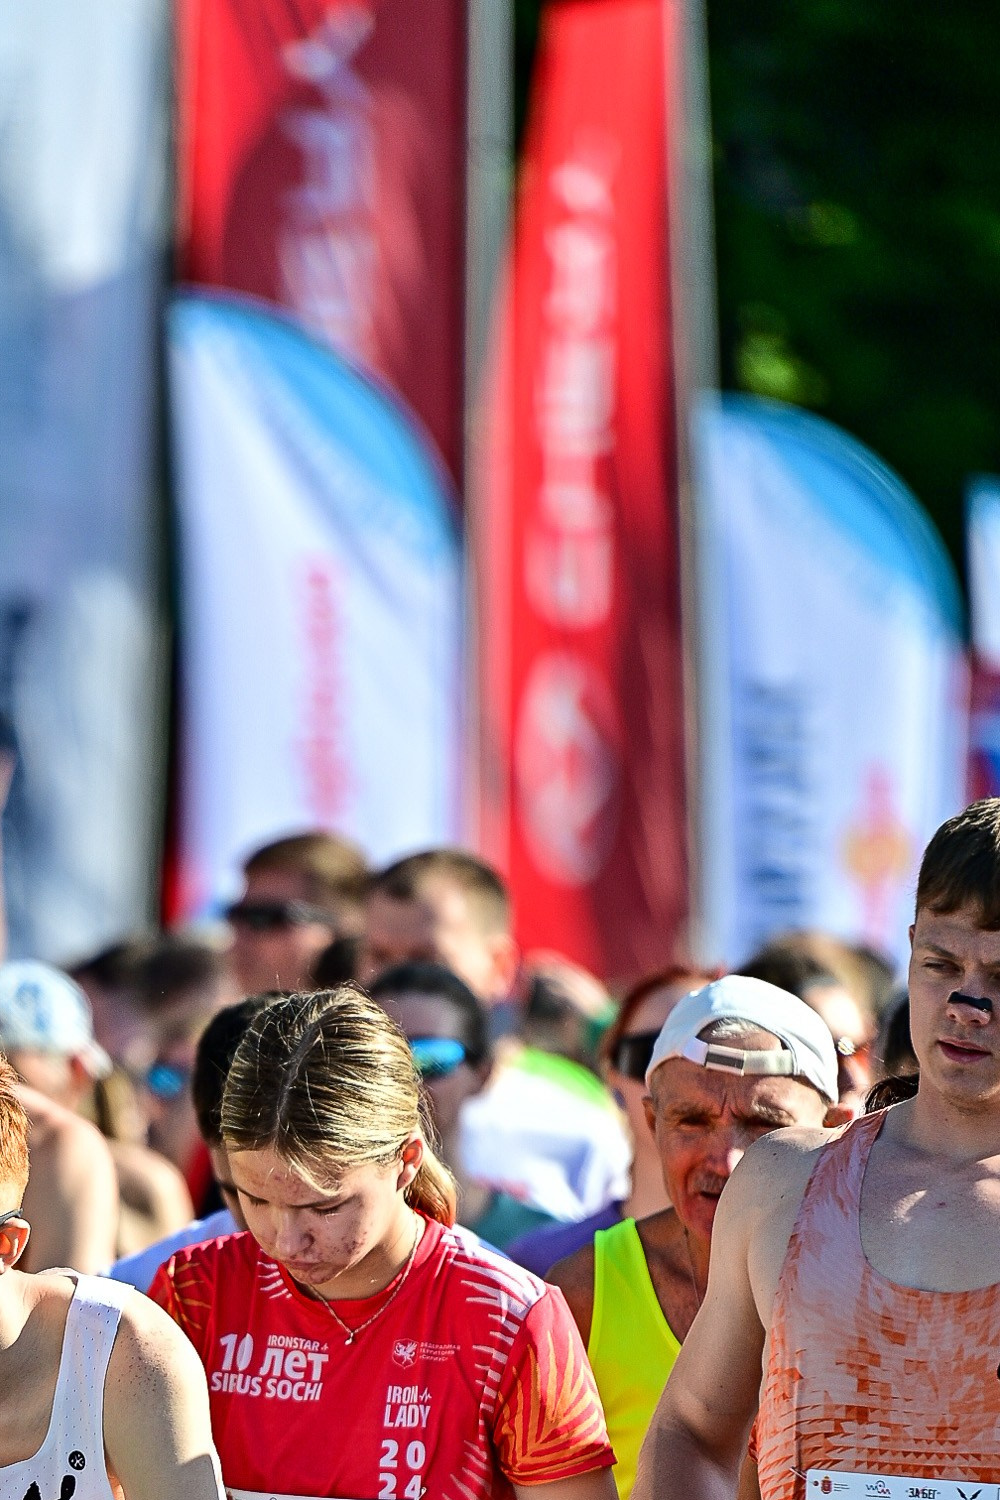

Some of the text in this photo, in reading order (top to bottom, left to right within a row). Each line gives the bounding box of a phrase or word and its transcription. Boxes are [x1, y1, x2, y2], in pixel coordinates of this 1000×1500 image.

[267, 1335, 320, 1351] IRONSTAR
[220, 1333, 329, 1380] 10 лет
[265, 1378, 323, 1401] SOCHI
[387, 1385, 418, 1404] IRON
[384, 1404, 431, 1428] LADY
